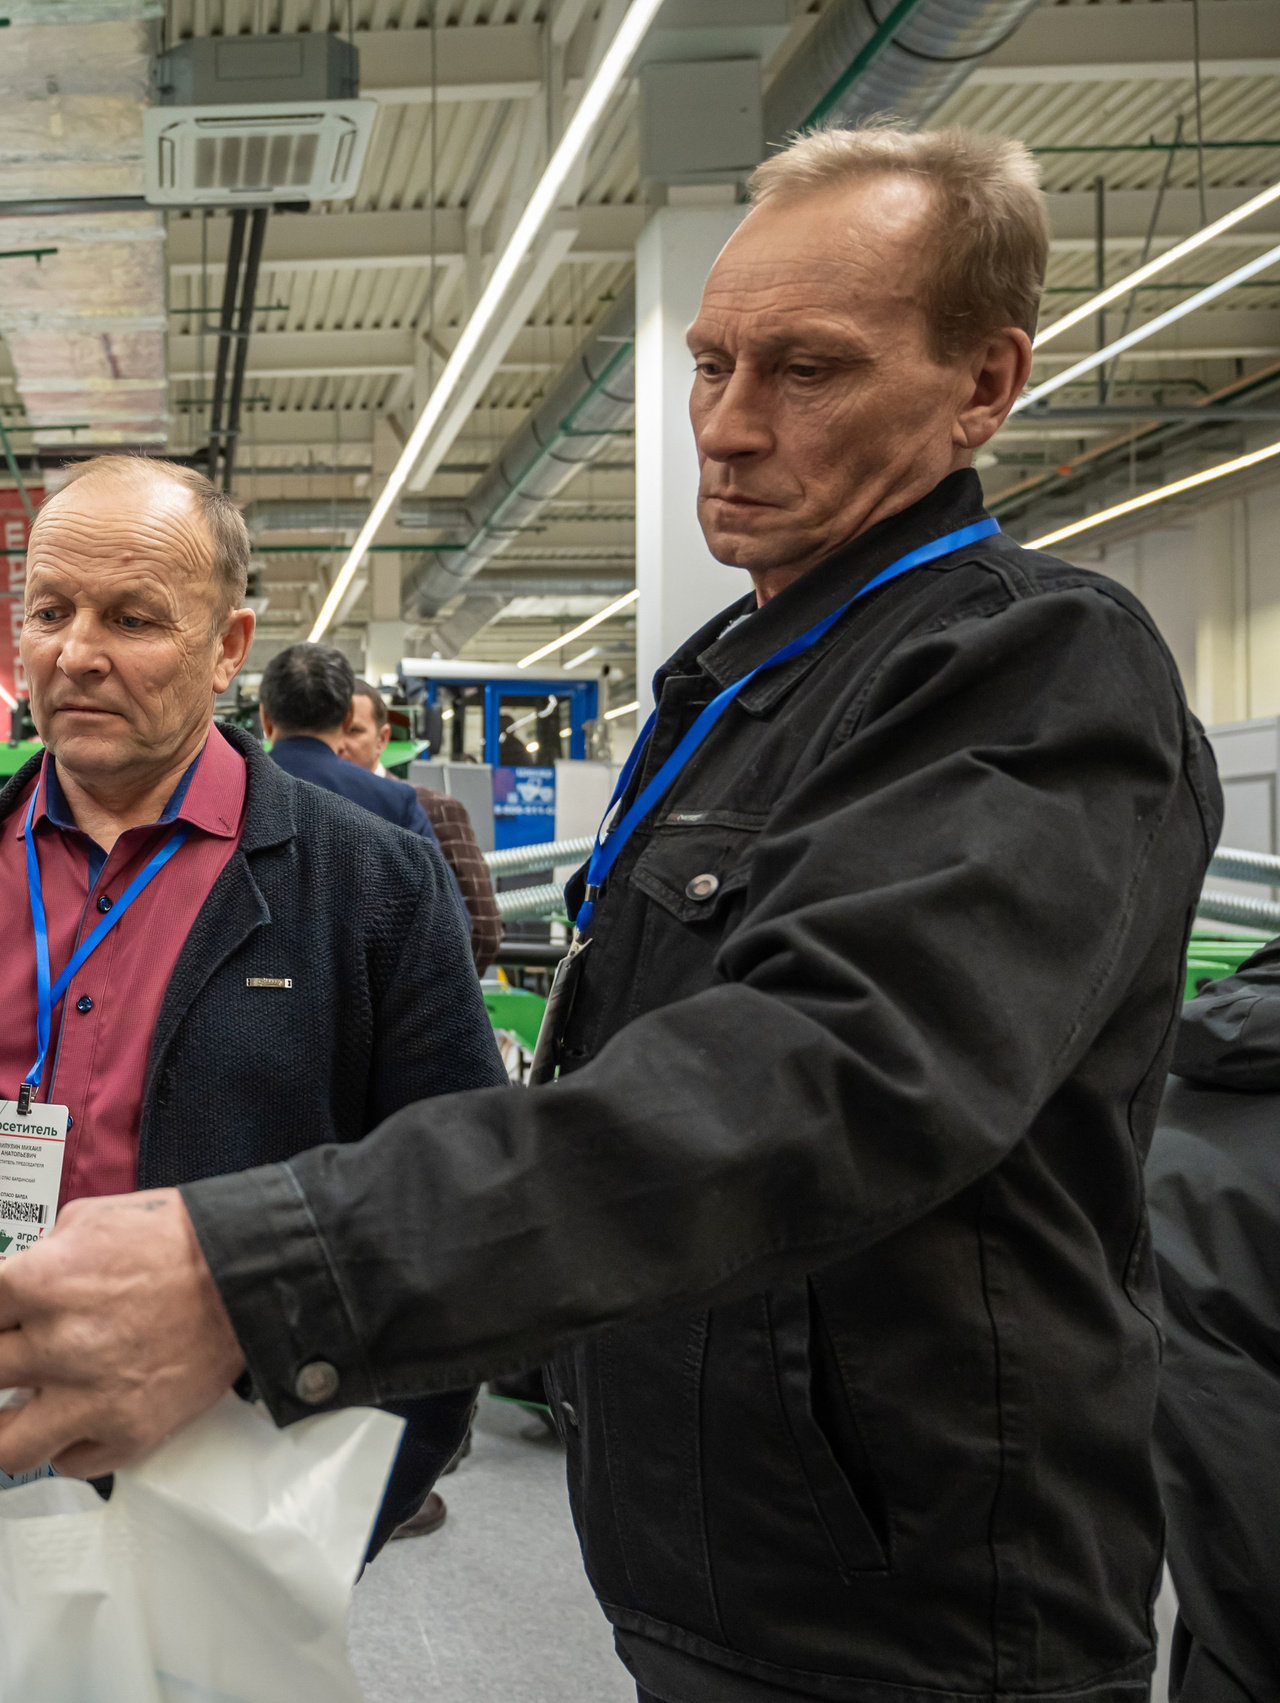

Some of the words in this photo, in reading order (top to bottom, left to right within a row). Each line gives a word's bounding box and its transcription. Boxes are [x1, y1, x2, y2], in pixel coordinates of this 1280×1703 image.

[21, 1144, 42, 1152] МИХАИЛ
[0, 1150, 37, 1159] АНАТОЛЬЕВИЧ
[17, 1231, 39, 1243] агро
